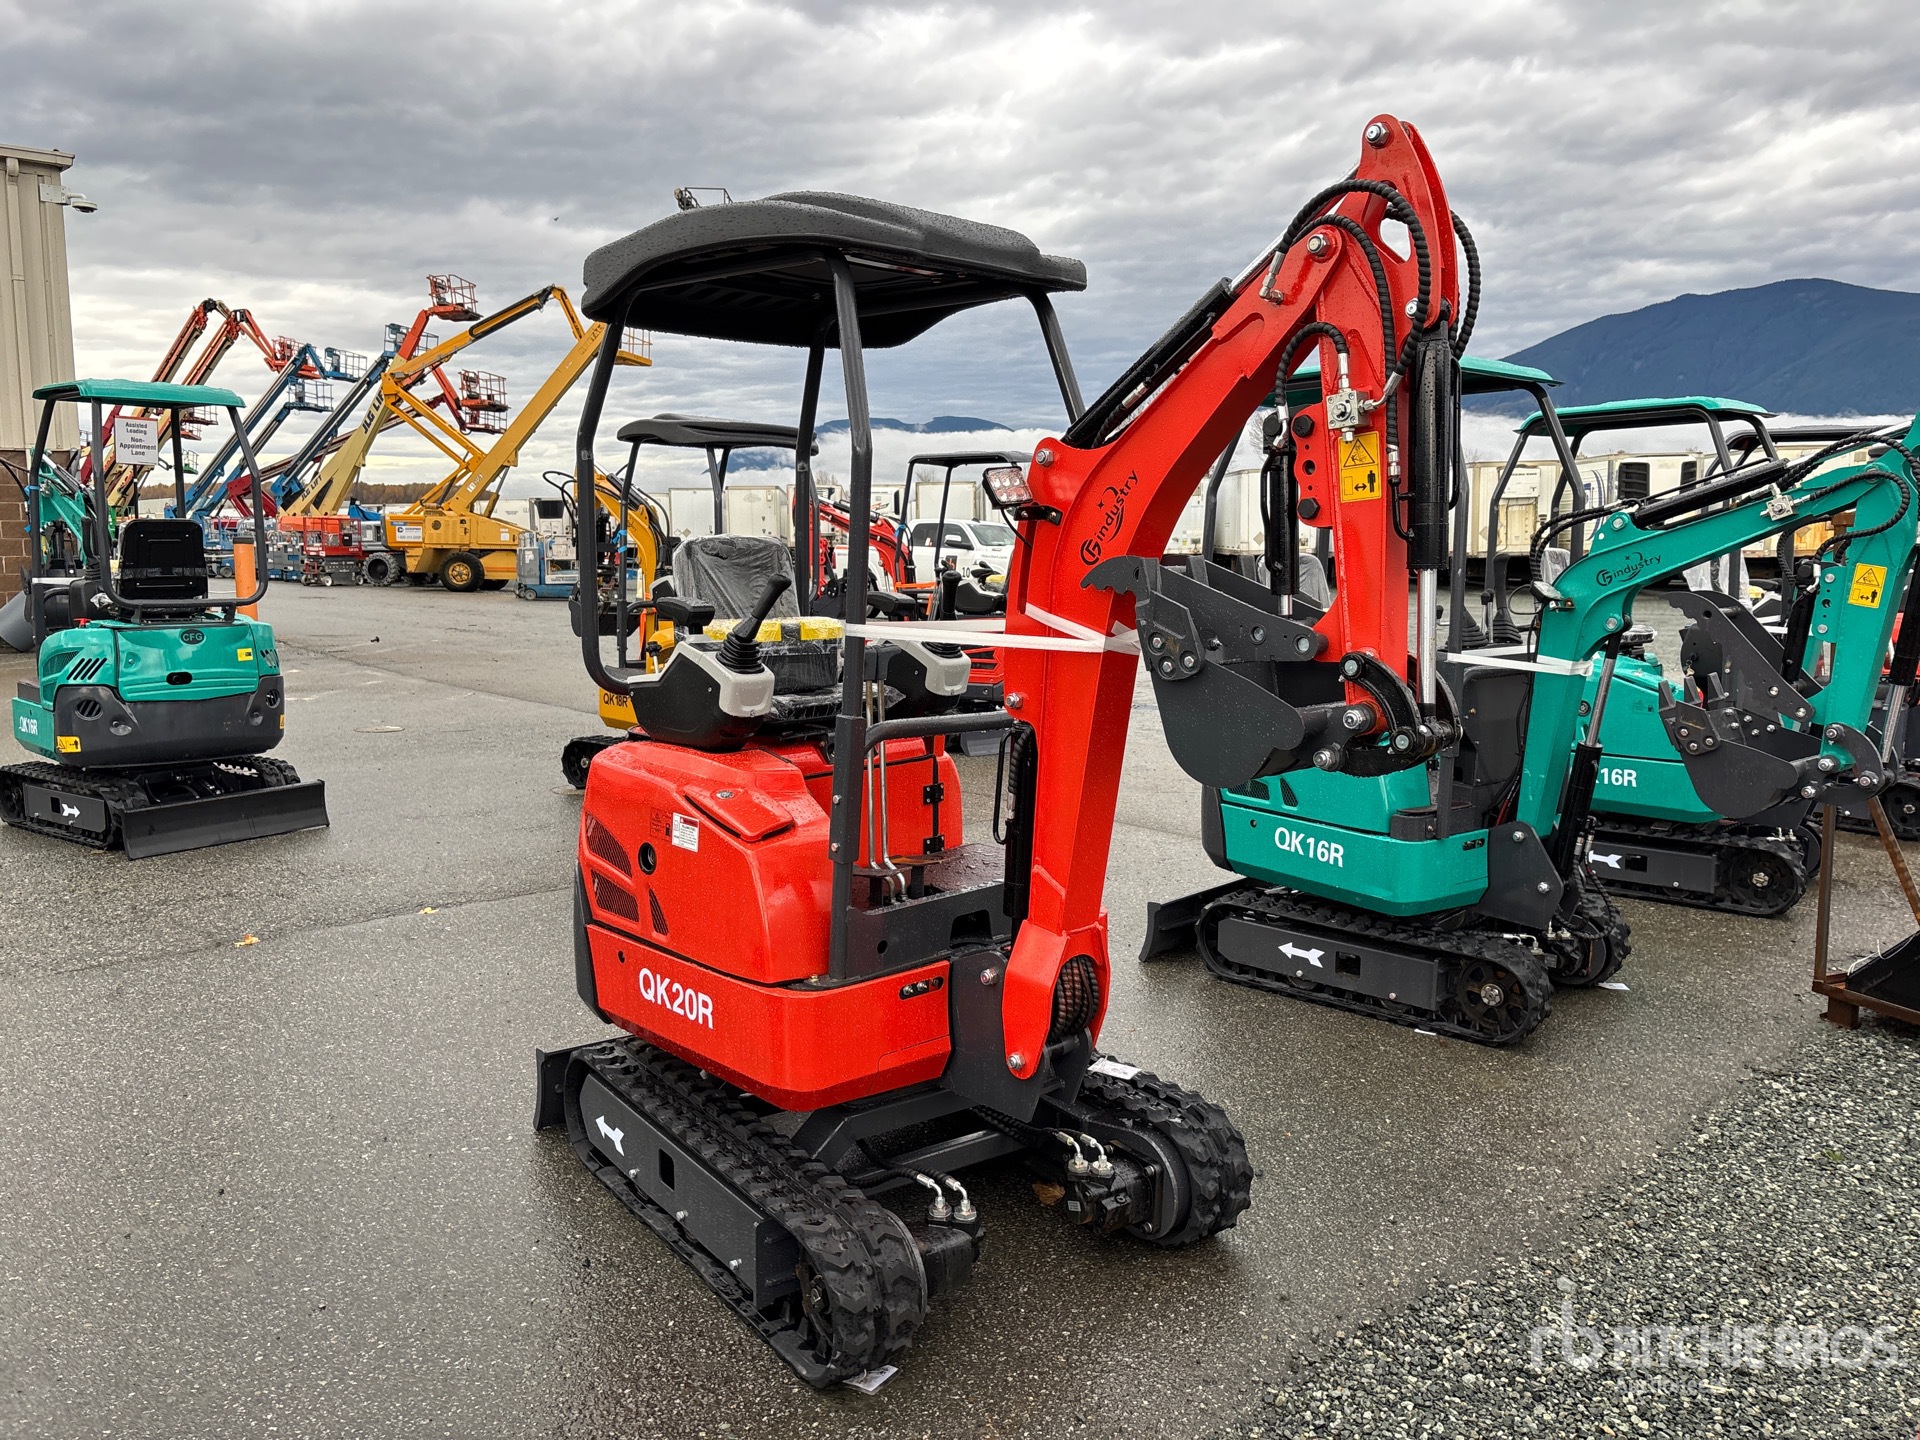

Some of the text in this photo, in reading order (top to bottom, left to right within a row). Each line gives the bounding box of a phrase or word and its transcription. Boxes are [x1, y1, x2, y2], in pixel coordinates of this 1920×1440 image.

[125, 421, 147, 429] Assisted
[362, 410, 375, 434] JLG
[119, 442, 157, 450] Appointment
[301, 474, 322, 502] JLG LIFT
[182, 633, 203, 642] CFG
[603, 692, 628, 708] QK18R
[1595, 767, 1637, 788] 16R
[1274, 826, 1344, 868] QK16R
[638, 967, 714, 1030] QK20R
